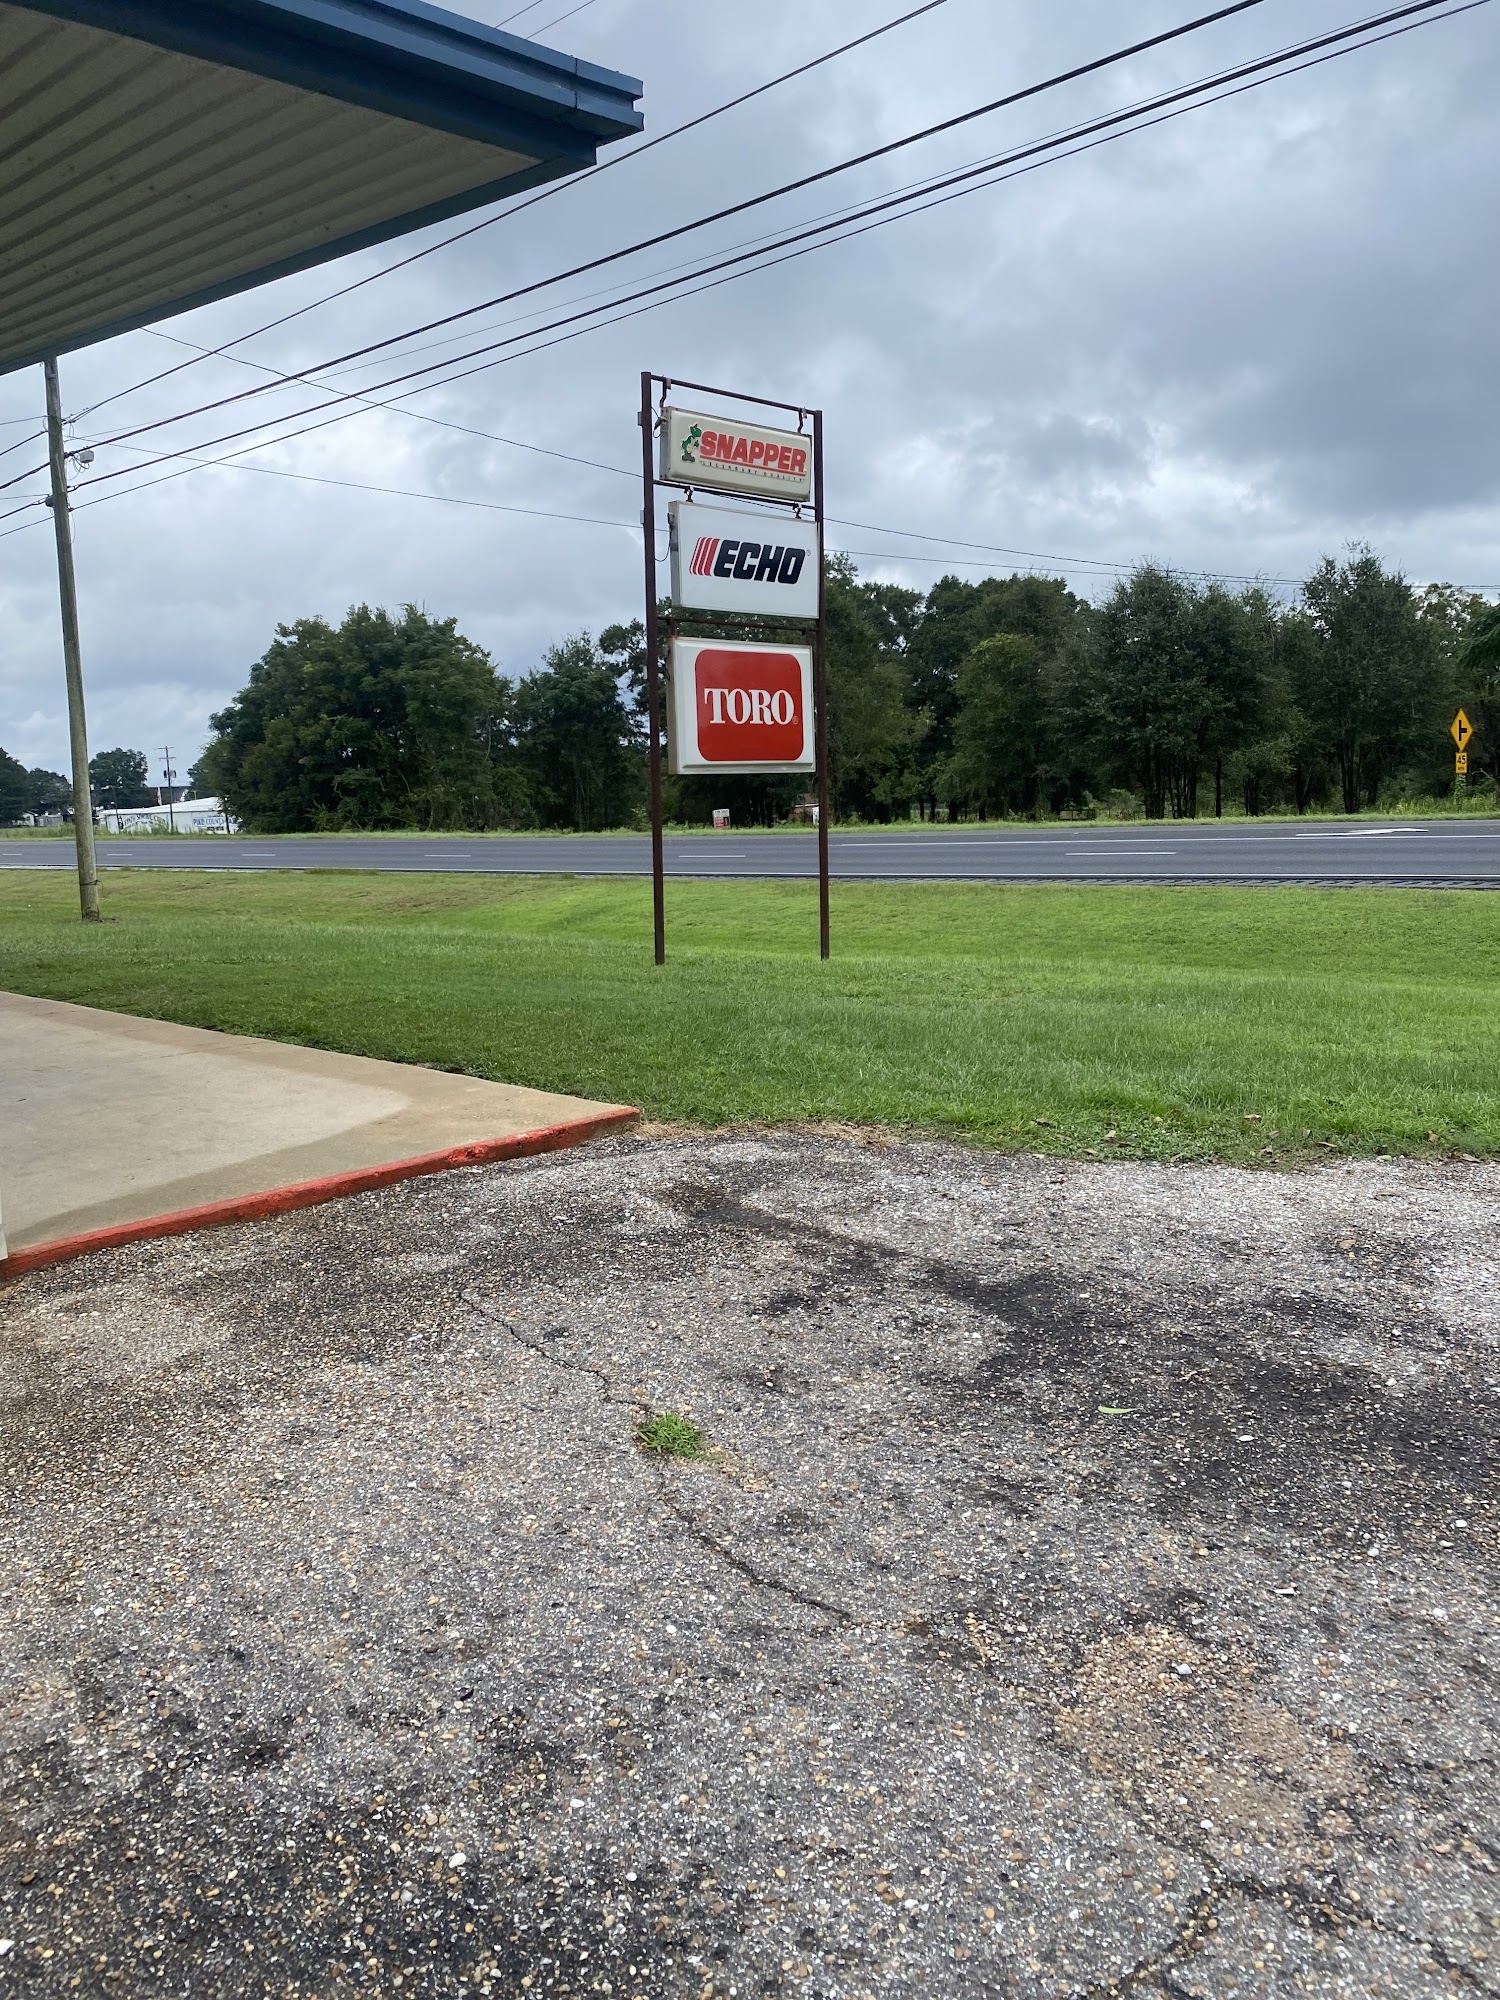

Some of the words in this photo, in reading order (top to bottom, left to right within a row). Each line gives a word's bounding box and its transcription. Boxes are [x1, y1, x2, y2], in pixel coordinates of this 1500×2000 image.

[700, 431, 807, 473] SNAPPER
[713, 540, 806, 585] ECHO
[704, 688, 795, 725] TORO
[1457, 755, 1466, 764] 45
